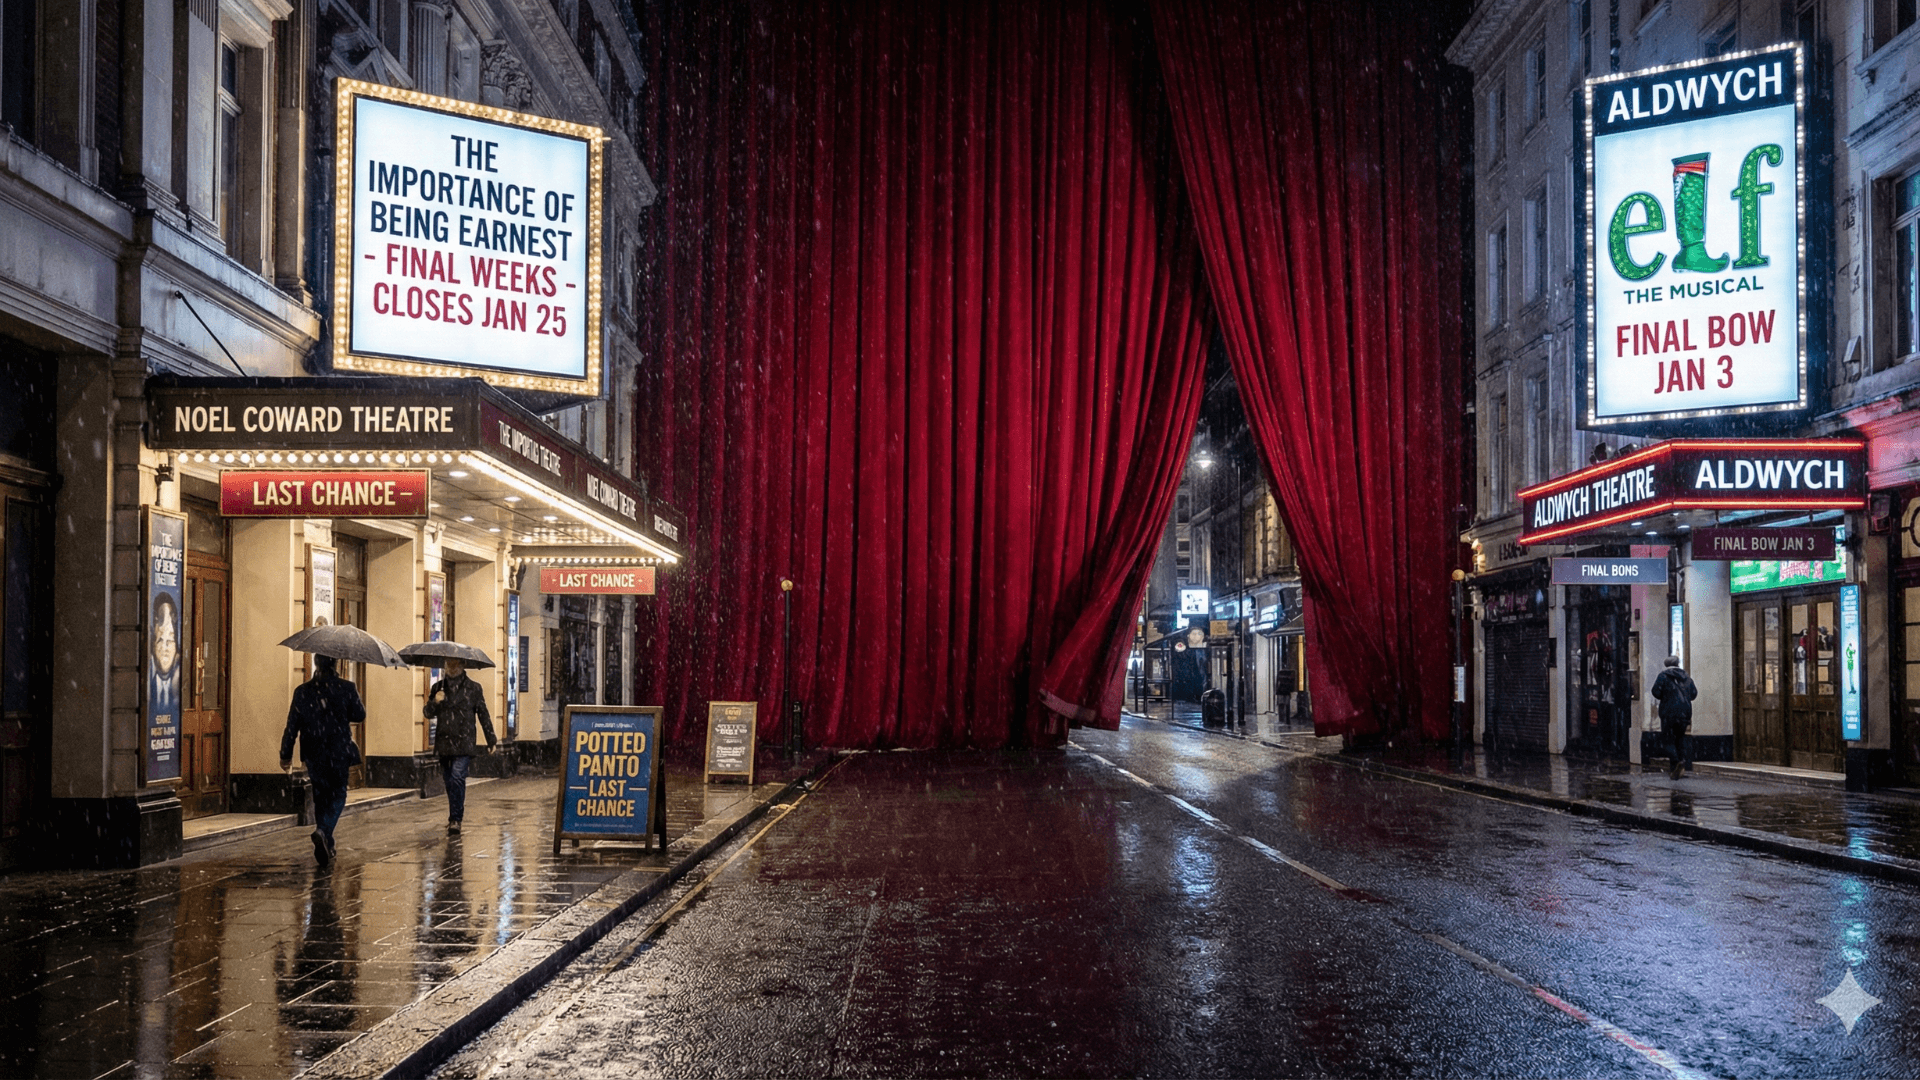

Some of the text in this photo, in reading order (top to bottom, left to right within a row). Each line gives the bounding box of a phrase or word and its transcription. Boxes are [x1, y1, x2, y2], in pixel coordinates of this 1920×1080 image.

[1607, 62, 1783, 124] ALDWYCH
[450, 134, 499, 173] THE
[368, 160, 575, 224] IMPORTANCE OF
[370, 201, 573, 261] BEING EARNEST
[385, 243, 460, 285] FINAL
[470, 256, 557, 298] WEEKS
[1623, 276, 1764, 305] THE MUSICAL
[373, 282, 567, 338] CLOSES JAN 25
[1616, 310, 1776, 358] FINAL BOW
[1653, 355, 1734, 395] JAN 3
[175, 405, 454, 434] NOEL COWARD THEATRE
[1695, 459, 1845, 490] ALDWYCH
[252, 481, 304, 506] LAST
[311, 480, 396, 506] CHANCE
[1534, 465, 1656, 528] ALDWYCH THEATRE
[1714, 536, 1815, 551] FINAL BOW JAN 3
[559, 573, 636, 588] LAST CHANCE
[1581, 564, 1639, 577] FINAL BONS
[575, 731, 646, 754] POTTED
[578, 755, 640, 777] PANTO
[589, 779, 627, 797] LAST
[576, 799, 636, 817] CHANCE
